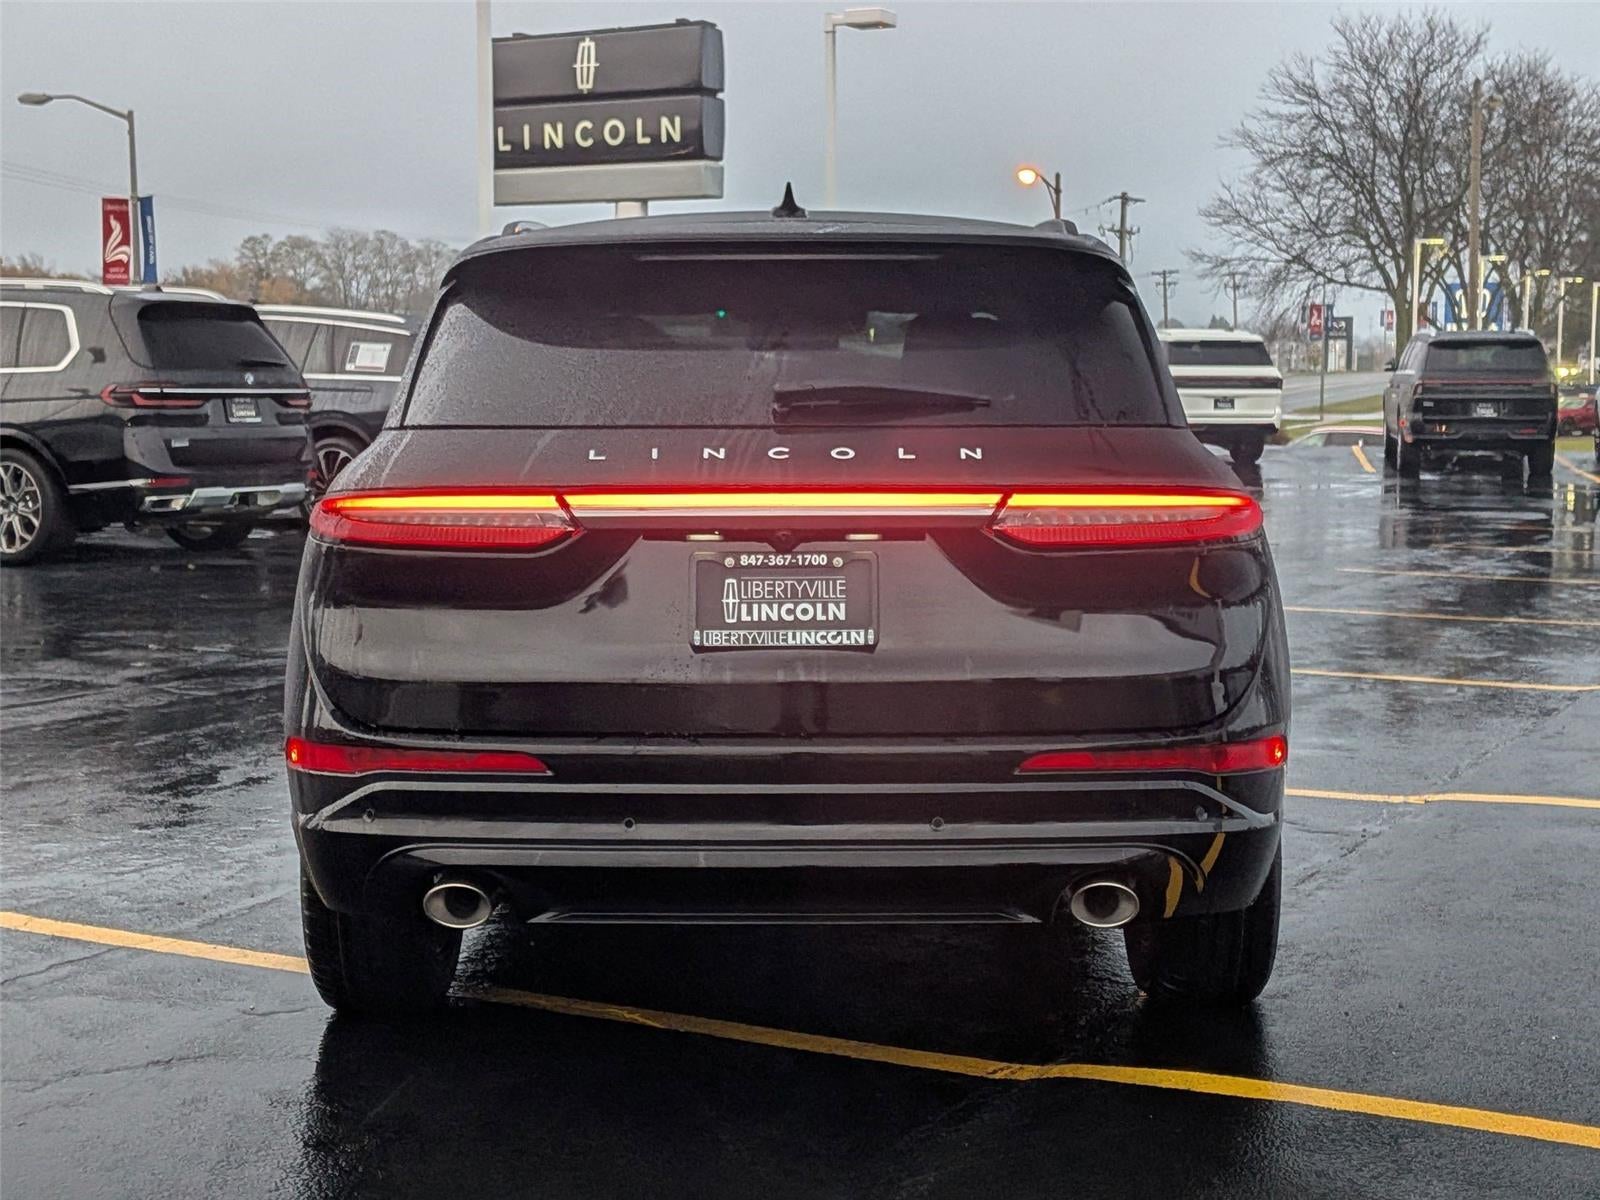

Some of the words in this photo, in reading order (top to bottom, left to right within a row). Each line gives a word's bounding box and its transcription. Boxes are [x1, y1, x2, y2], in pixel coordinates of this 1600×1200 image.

[497, 115, 682, 152] LINCOLN
[588, 447, 983, 461] LINCOLN
[740, 554, 828, 566] 847-367-1700
[740, 580, 847, 599] LIBERTYVILLE
[740, 603, 846, 622] LINCOLN
